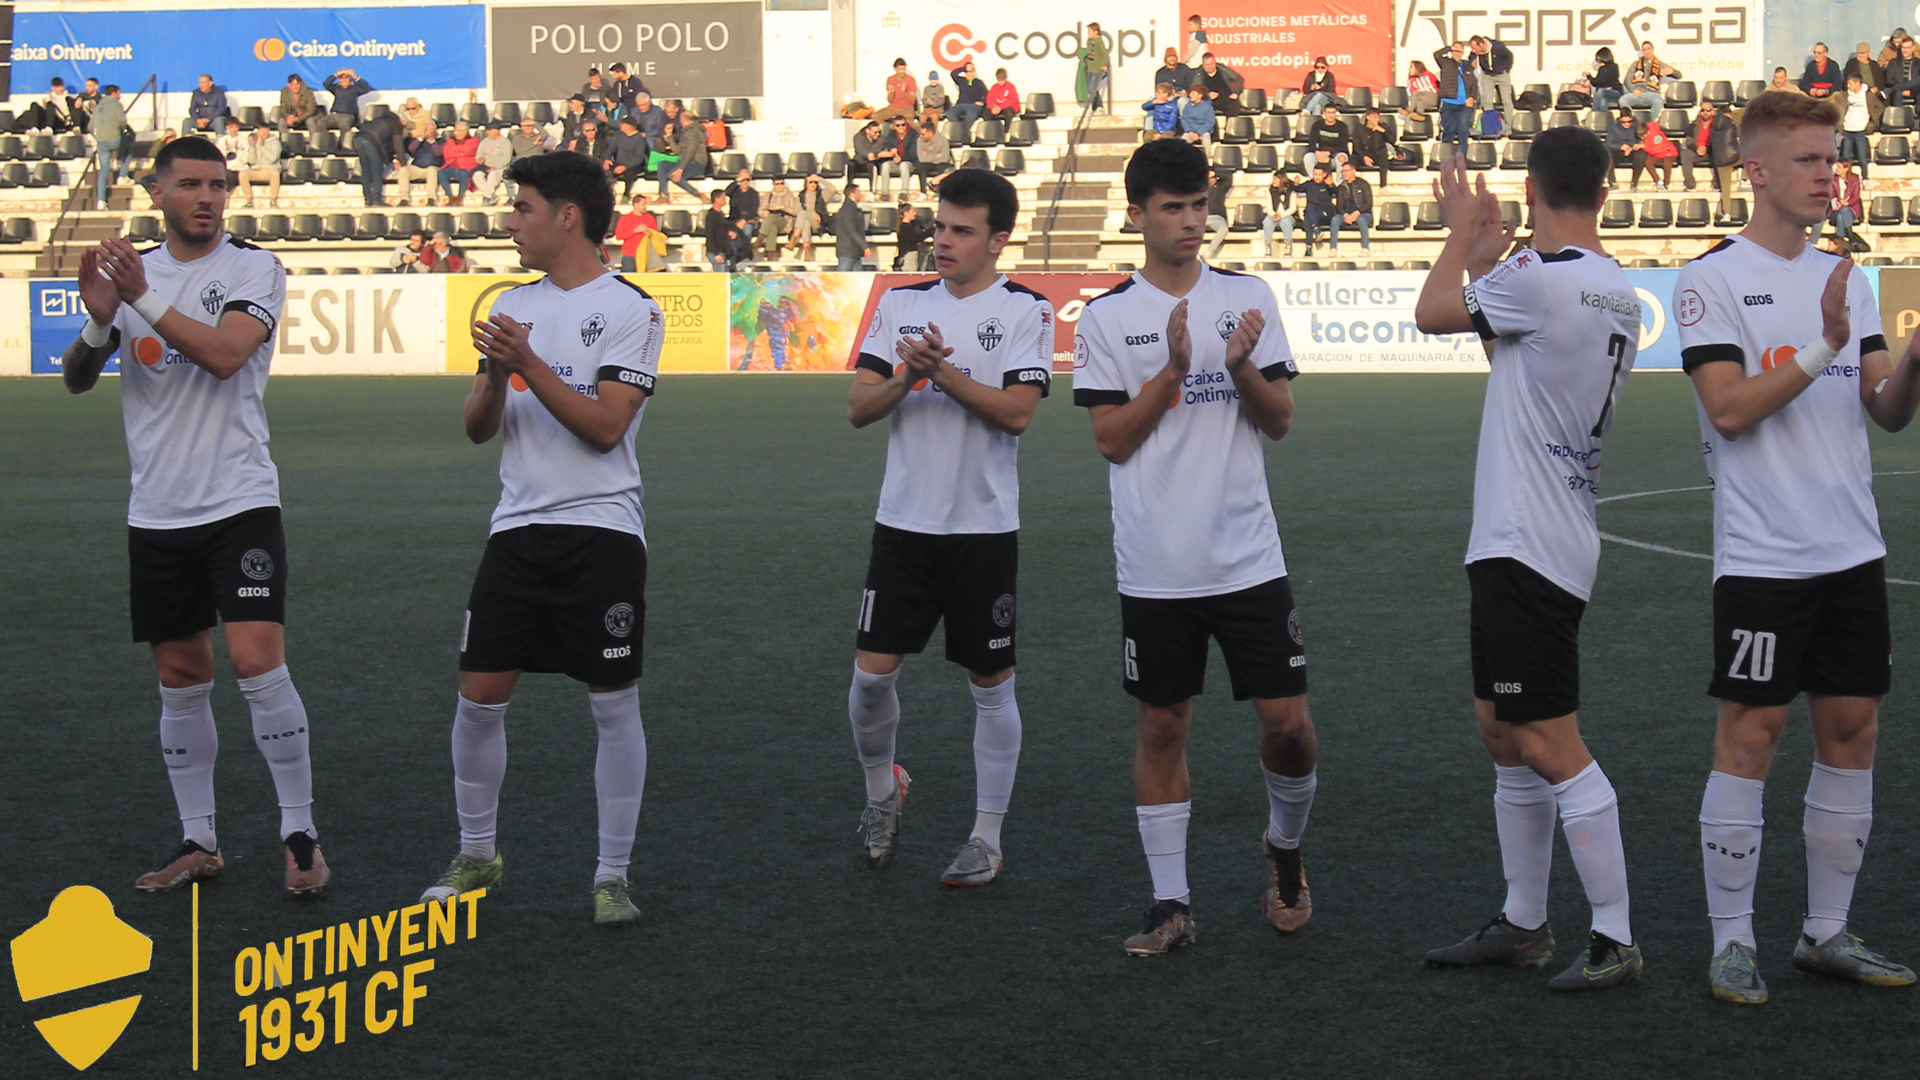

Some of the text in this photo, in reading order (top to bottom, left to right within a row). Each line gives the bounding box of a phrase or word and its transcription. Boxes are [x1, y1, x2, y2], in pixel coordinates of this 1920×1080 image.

[1200, 13, 1368, 29] SOLUCIONES METÁLICAS
[531, 21, 729, 54] POLO POLO
[1206, 32, 1296, 45] NDUSTRIALES
[11, 42, 133, 64] aixa Ontinyent
[288, 38, 426, 61] Caixa Ontinyent
[1215, 52, 1352, 69] ww.codopi.om
[1285, 282, 1416, 306] talleres
[1743, 294, 1774, 306] GIOS
[898, 325, 926, 335] GIOS
[680, 336, 703, 345] AREA
[1125, 332, 1160, 346] GIOS
[1359, 353, 1375, 363] DE
[1380, 353, 1454, 363] MAQUINARIA
[1459, 353, 1475, 363] EN
[550, 361, 573, 377] aixa
[618, 370, 653, 389] GIOS
[1183, 369, 1225, 388] Caixa
[1590, 332, 1627, 438] 7
[1185, 386, 1241, 405] Ontinye
[238, 587, 270, 597] GIOS
[988, 636, 1011, 649] GIOS
[603, 646, 631, 659] GIOS
[1728, 628, 1776, 682] 20
[1494, 682, 1523, 694] GIOS
